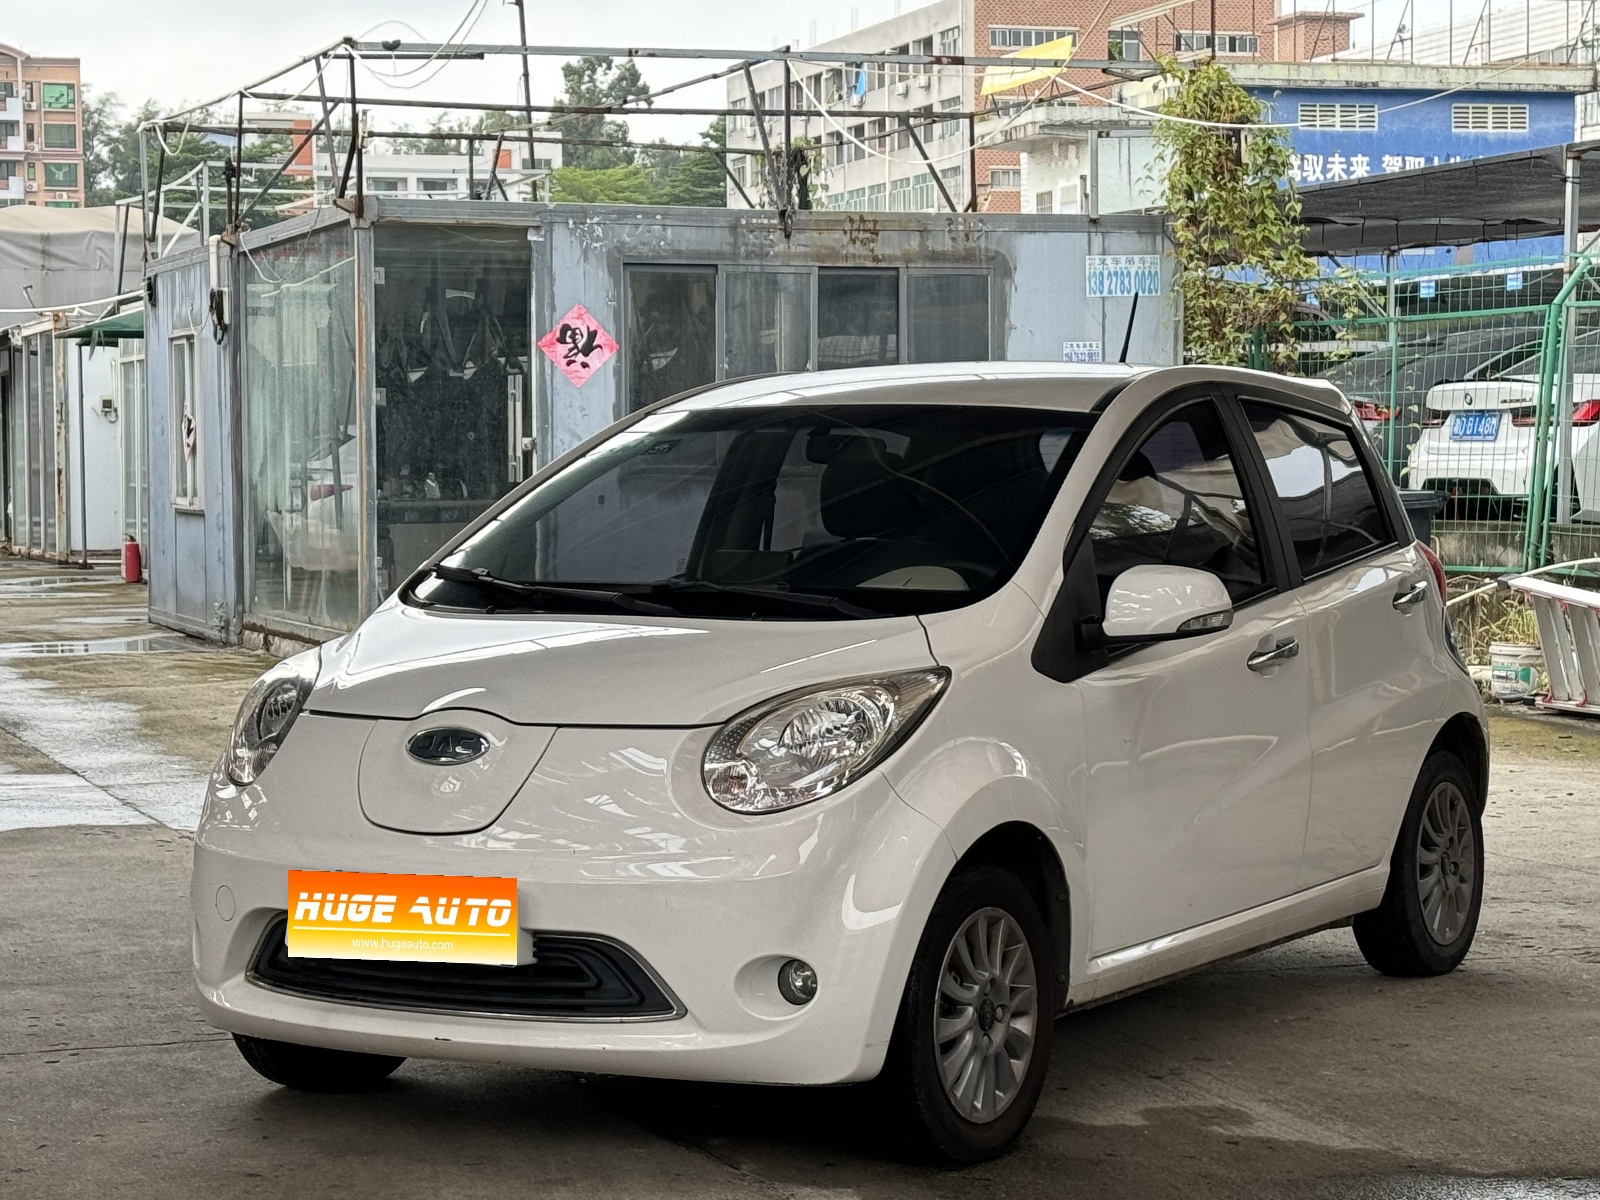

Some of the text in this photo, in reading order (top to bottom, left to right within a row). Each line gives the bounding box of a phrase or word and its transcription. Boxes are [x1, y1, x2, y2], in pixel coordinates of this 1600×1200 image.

[1088, 270, 1159, 295] 138 2783 0020
